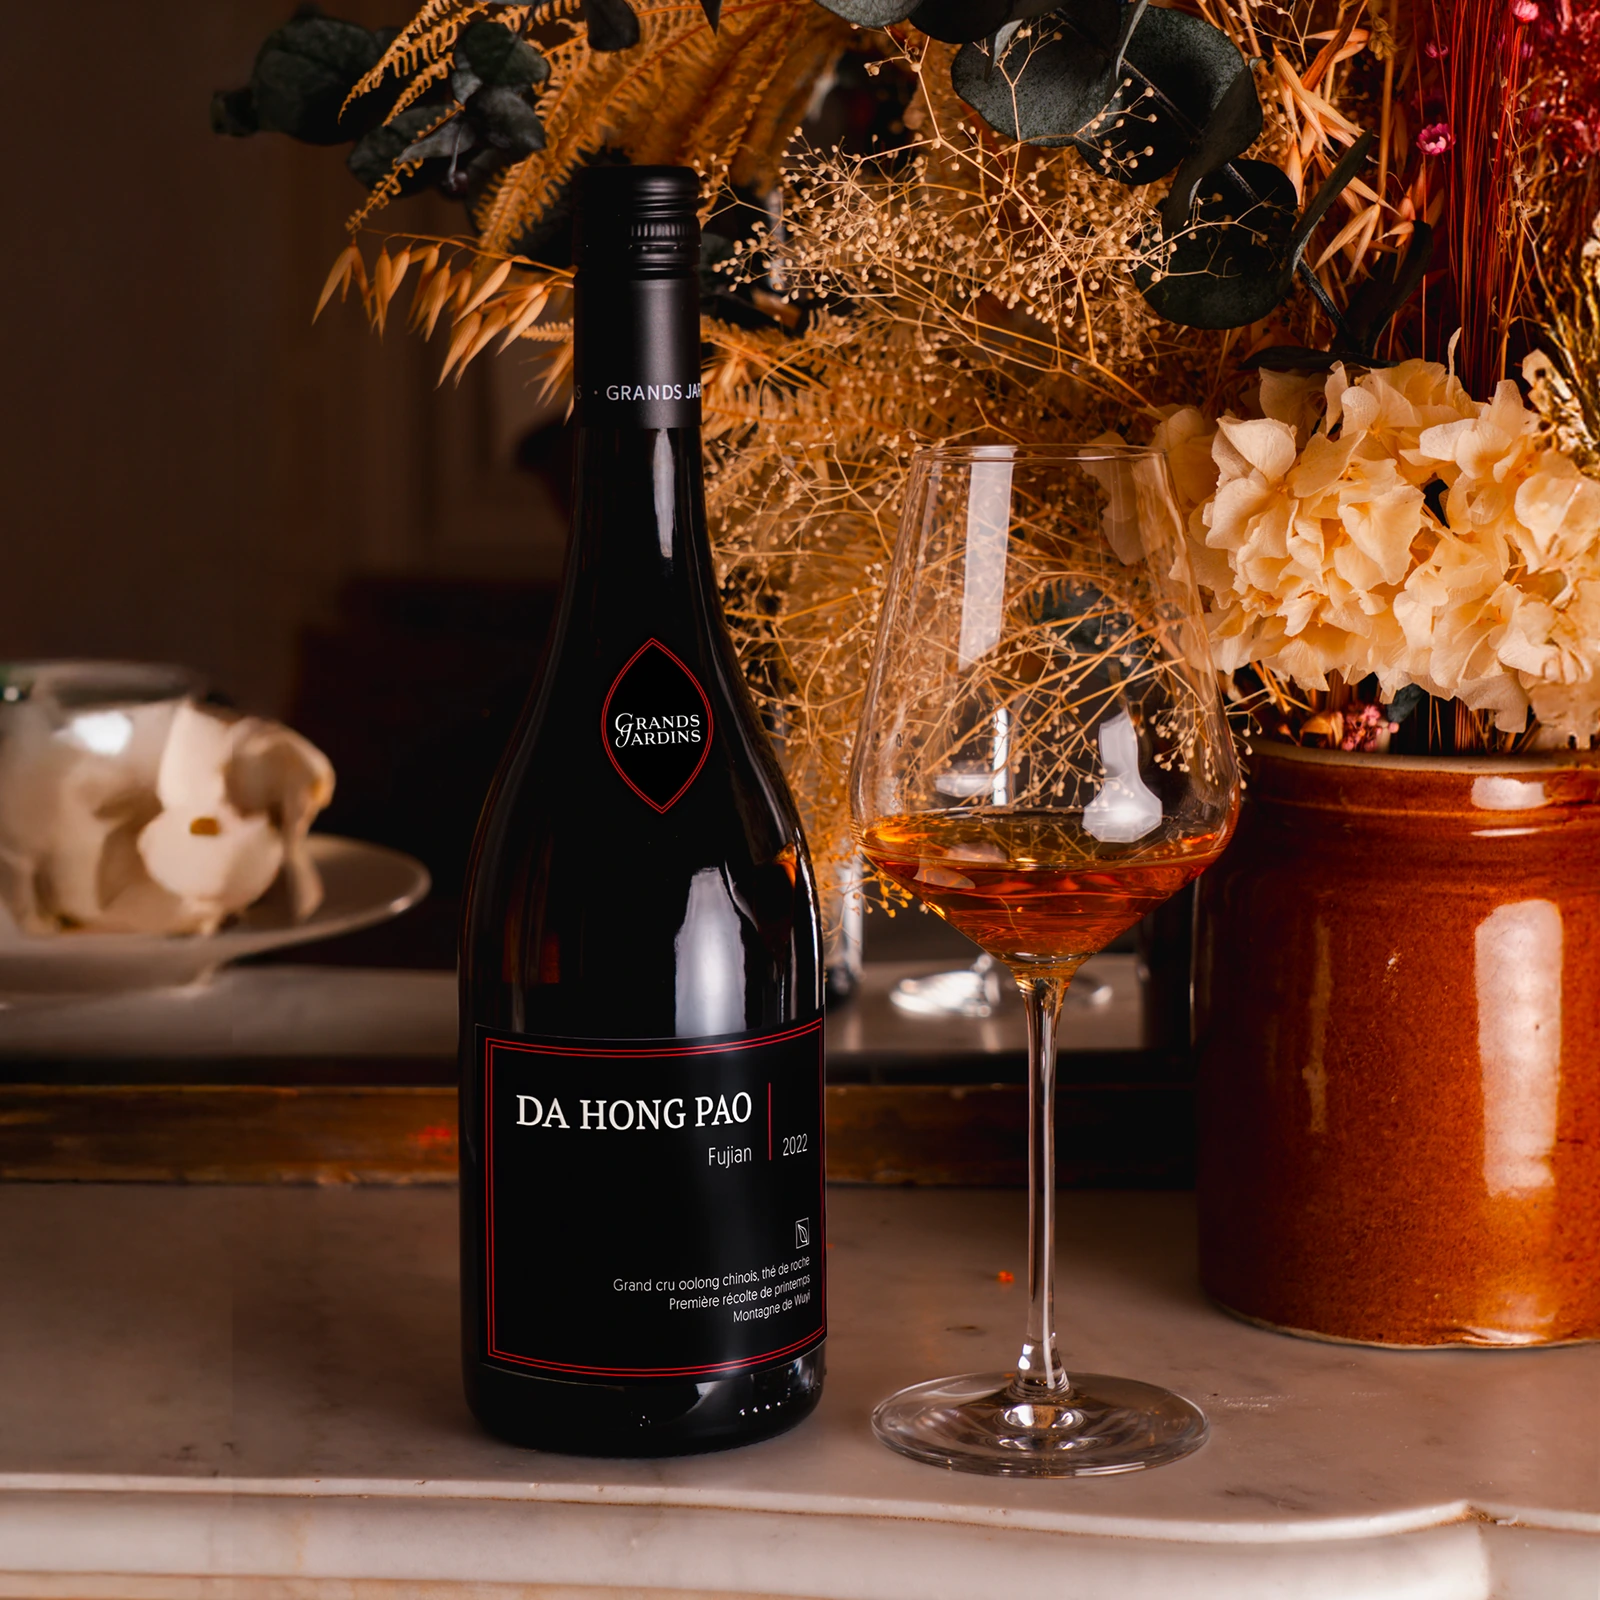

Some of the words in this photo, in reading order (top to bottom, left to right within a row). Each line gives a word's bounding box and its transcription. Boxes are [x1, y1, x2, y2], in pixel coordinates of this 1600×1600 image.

[606, 384, 682, 400] GRANDS
[615, 713, 700, 732] GRANDS
[615, 723, 701, 748] JARDINS
[516, 1094, 570, 1129] DA
[579, 1098, 686, 1130] HONG
[695, 1091, 752, 1127] PAO
[782, 1133, 808, 1156] 2022
[708, 1146, 752, 1169] Fujian
[613, 1278, 652, 1292] Grand
[655, 1280, 675, 1291] cru
[678, 1276, 720, 1290] oolong
[722, 1270, 760, 1286] chinois,
[762, 1265, 776, 1279] thé
[778, 1262, 789, 1275] de
[790, 1256, 810, 1271] roche
[669, 1295, 720, 1310] Première
[722, 1289, 758, 1305] récolte
[760, 1286, 773, 1299] de
[774, 1274, 810, 1297] printemps
[733, 1304, 780, 1323] Montagne
[782, 1298, 793, 1311] de
[794, 1289, 810, 1306] Wuyi
